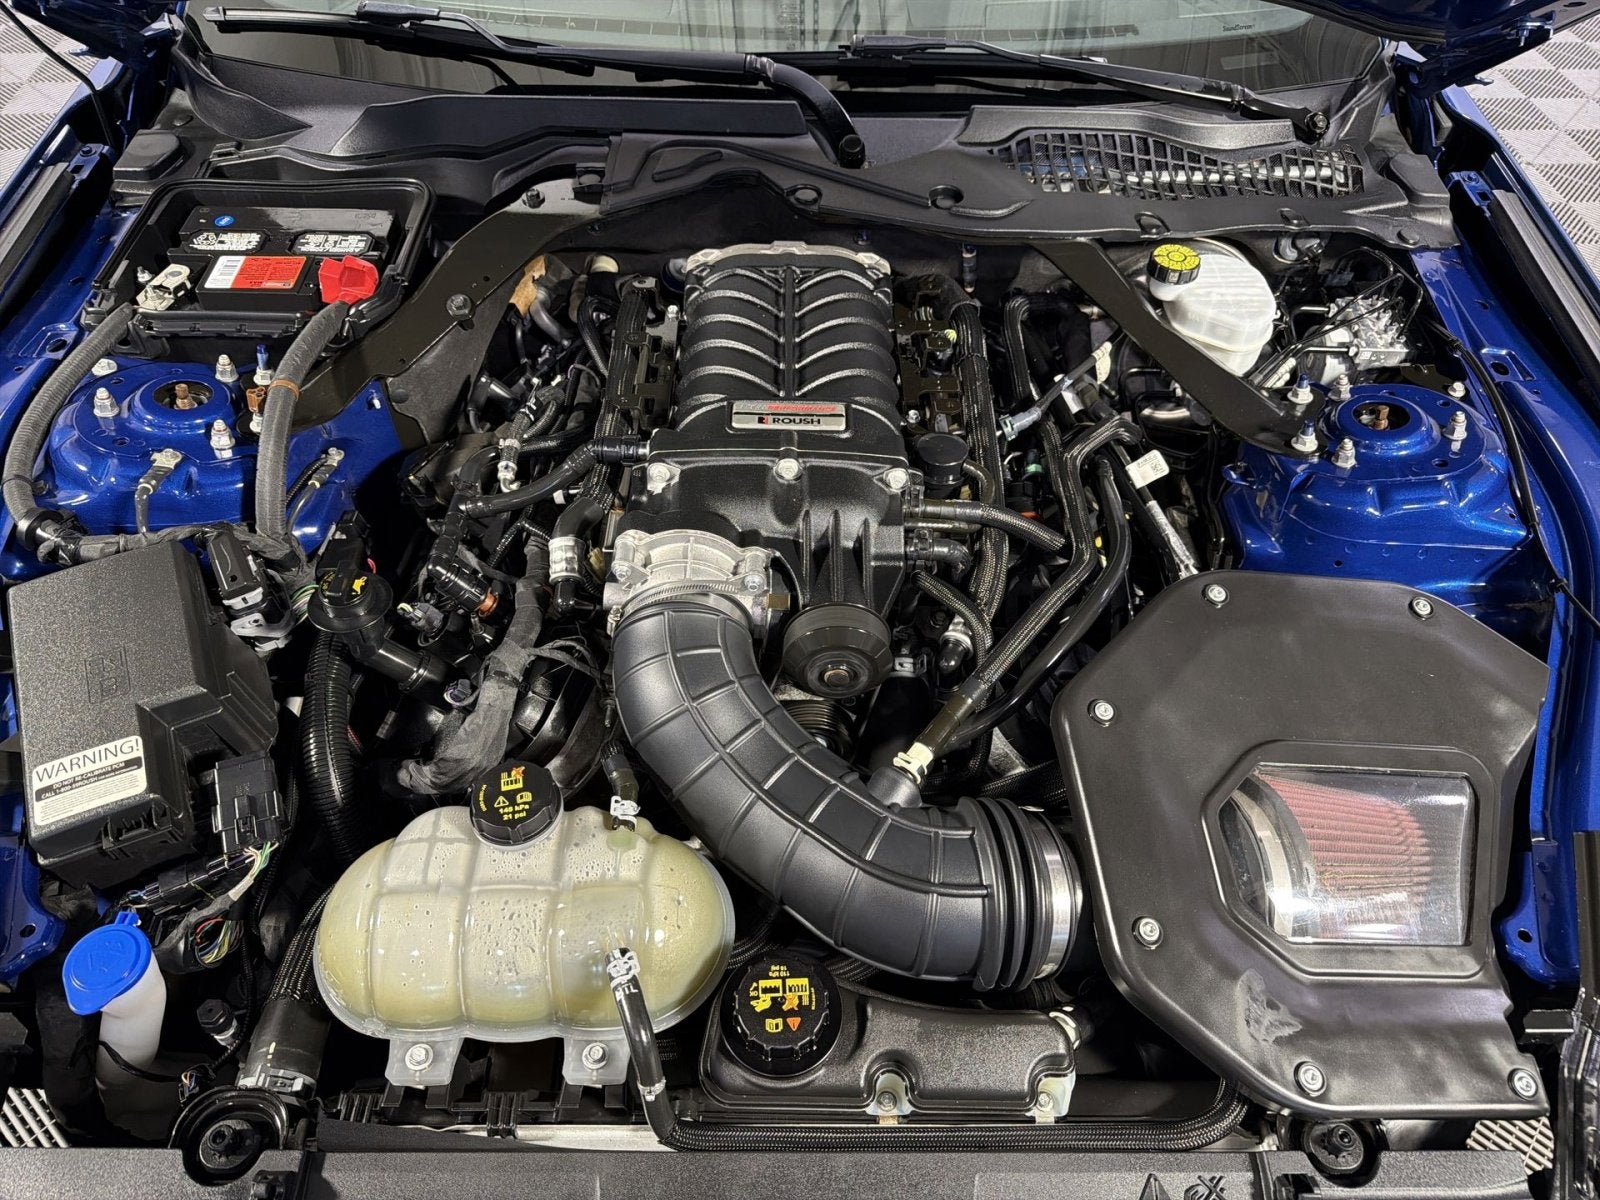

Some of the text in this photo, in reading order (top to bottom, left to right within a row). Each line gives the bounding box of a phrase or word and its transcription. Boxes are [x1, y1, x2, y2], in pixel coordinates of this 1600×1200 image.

[772, 417, 821, 425] ROUSH
[35, 738, 140, 783] WARNING!
[41, 790, 56, 799] CALL
